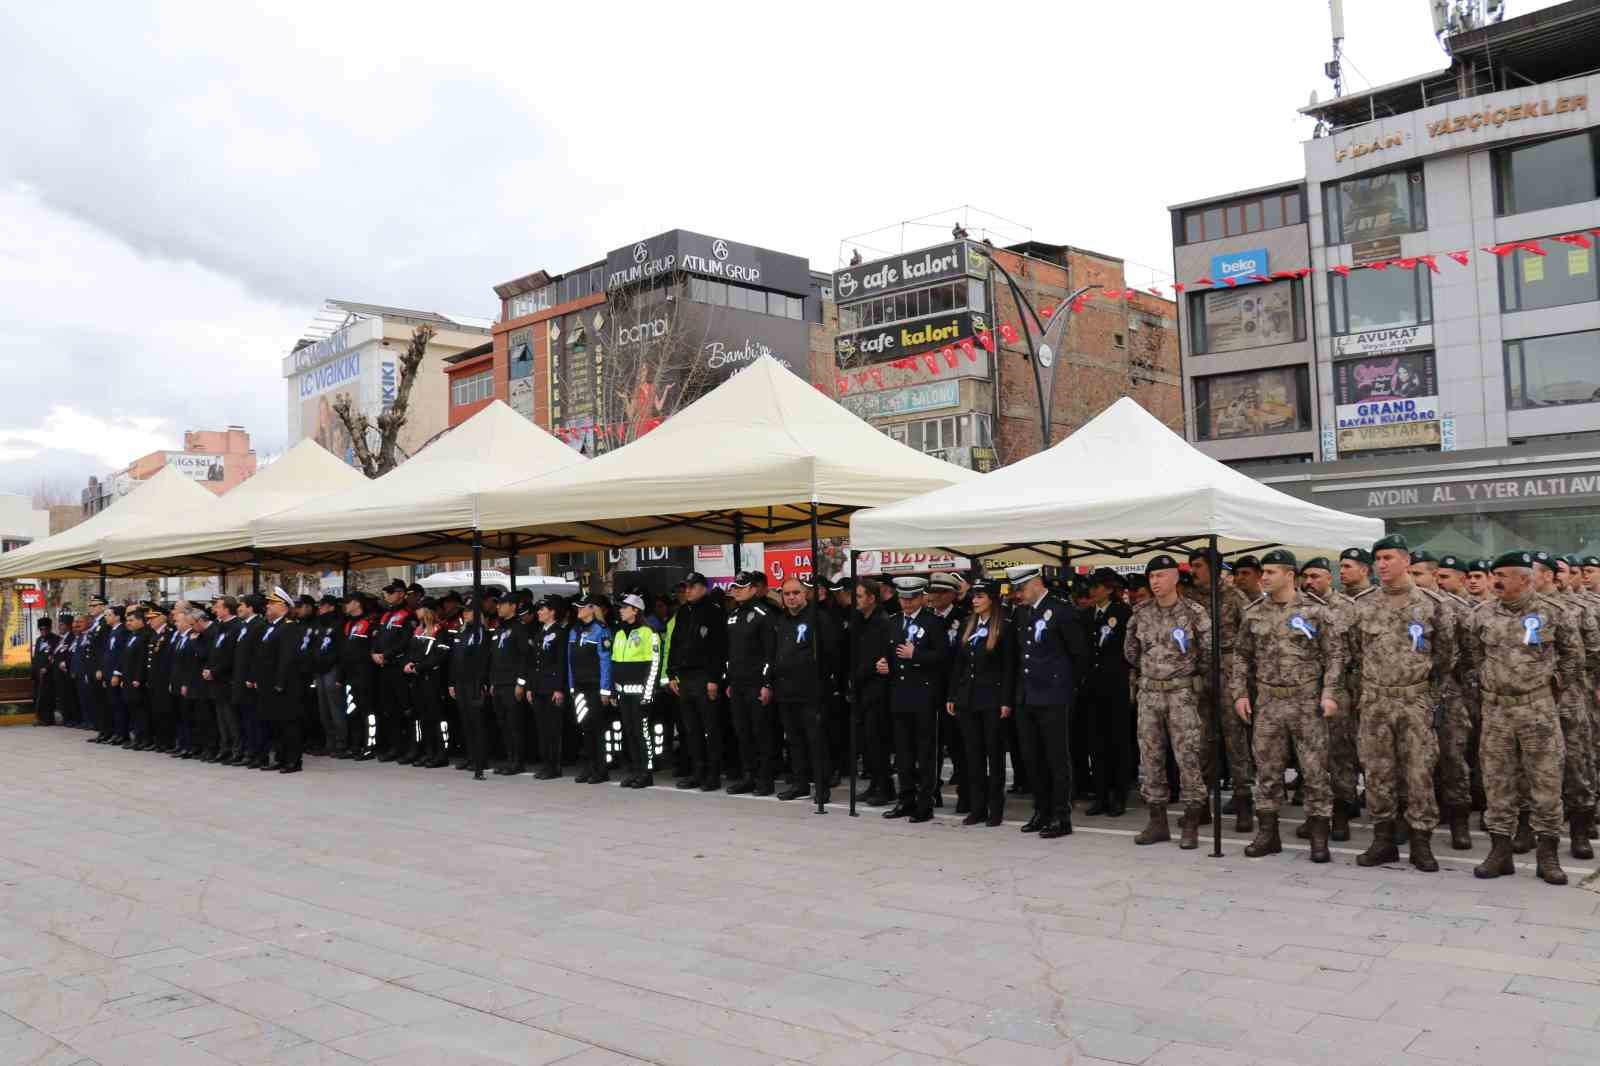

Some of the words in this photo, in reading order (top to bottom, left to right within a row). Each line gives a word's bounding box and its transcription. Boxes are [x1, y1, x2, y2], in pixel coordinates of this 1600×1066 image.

[608, 264, 642, 288] ATILIM
[644, 254, 675, 276] GRUP
[682, 254, 722, 275] ATILIM
[725, 263, 760, 281] GRUP
[863, 264, 899, 288] cafe
[902, 248, 958, 279] kalori
[1221, 257, 1257, 274] beko
[860, 332, 894, 352] cafe
[901, 319, 959, 347] kalori
[1356, 327, 1419, 344] AVUKAT
[1357, 399, 1416, 417] GRAND
[1339, 417, 1375, 428] BAYAN
[1367, 488, 1419, 507] AYDIN
[1482, 481, 1520, 499] YER
[1523, 478, 1567, 497] ALTI
[1570, 475, 1600, 493] AV
